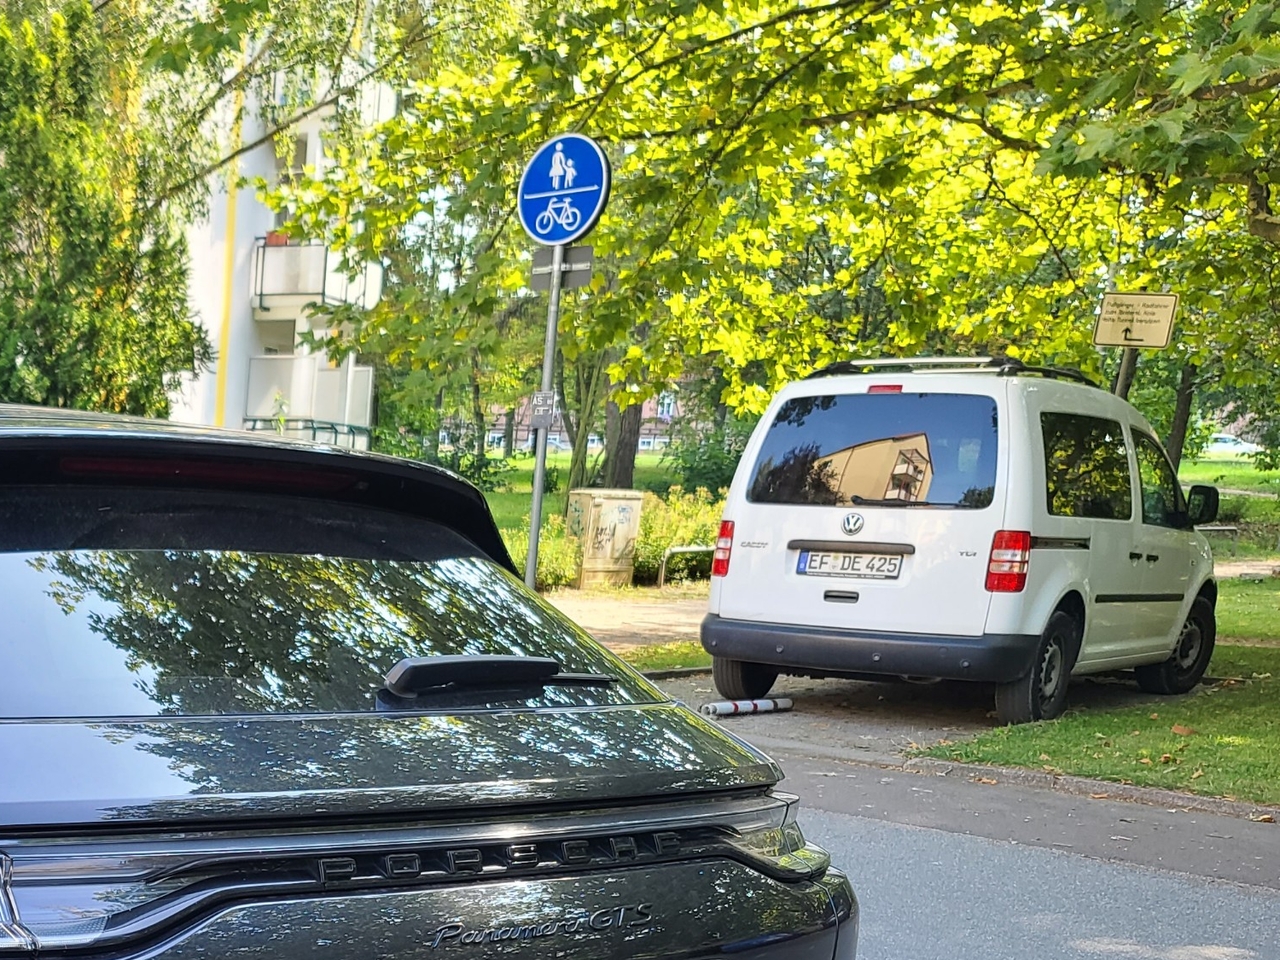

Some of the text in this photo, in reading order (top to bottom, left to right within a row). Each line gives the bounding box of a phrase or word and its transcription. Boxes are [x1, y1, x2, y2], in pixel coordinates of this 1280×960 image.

[807, 553, 900, 573] EF DE 425
[319, 832, 681, 885] PORSCHE
[431, 902, 654, 949] Panamera GTS
